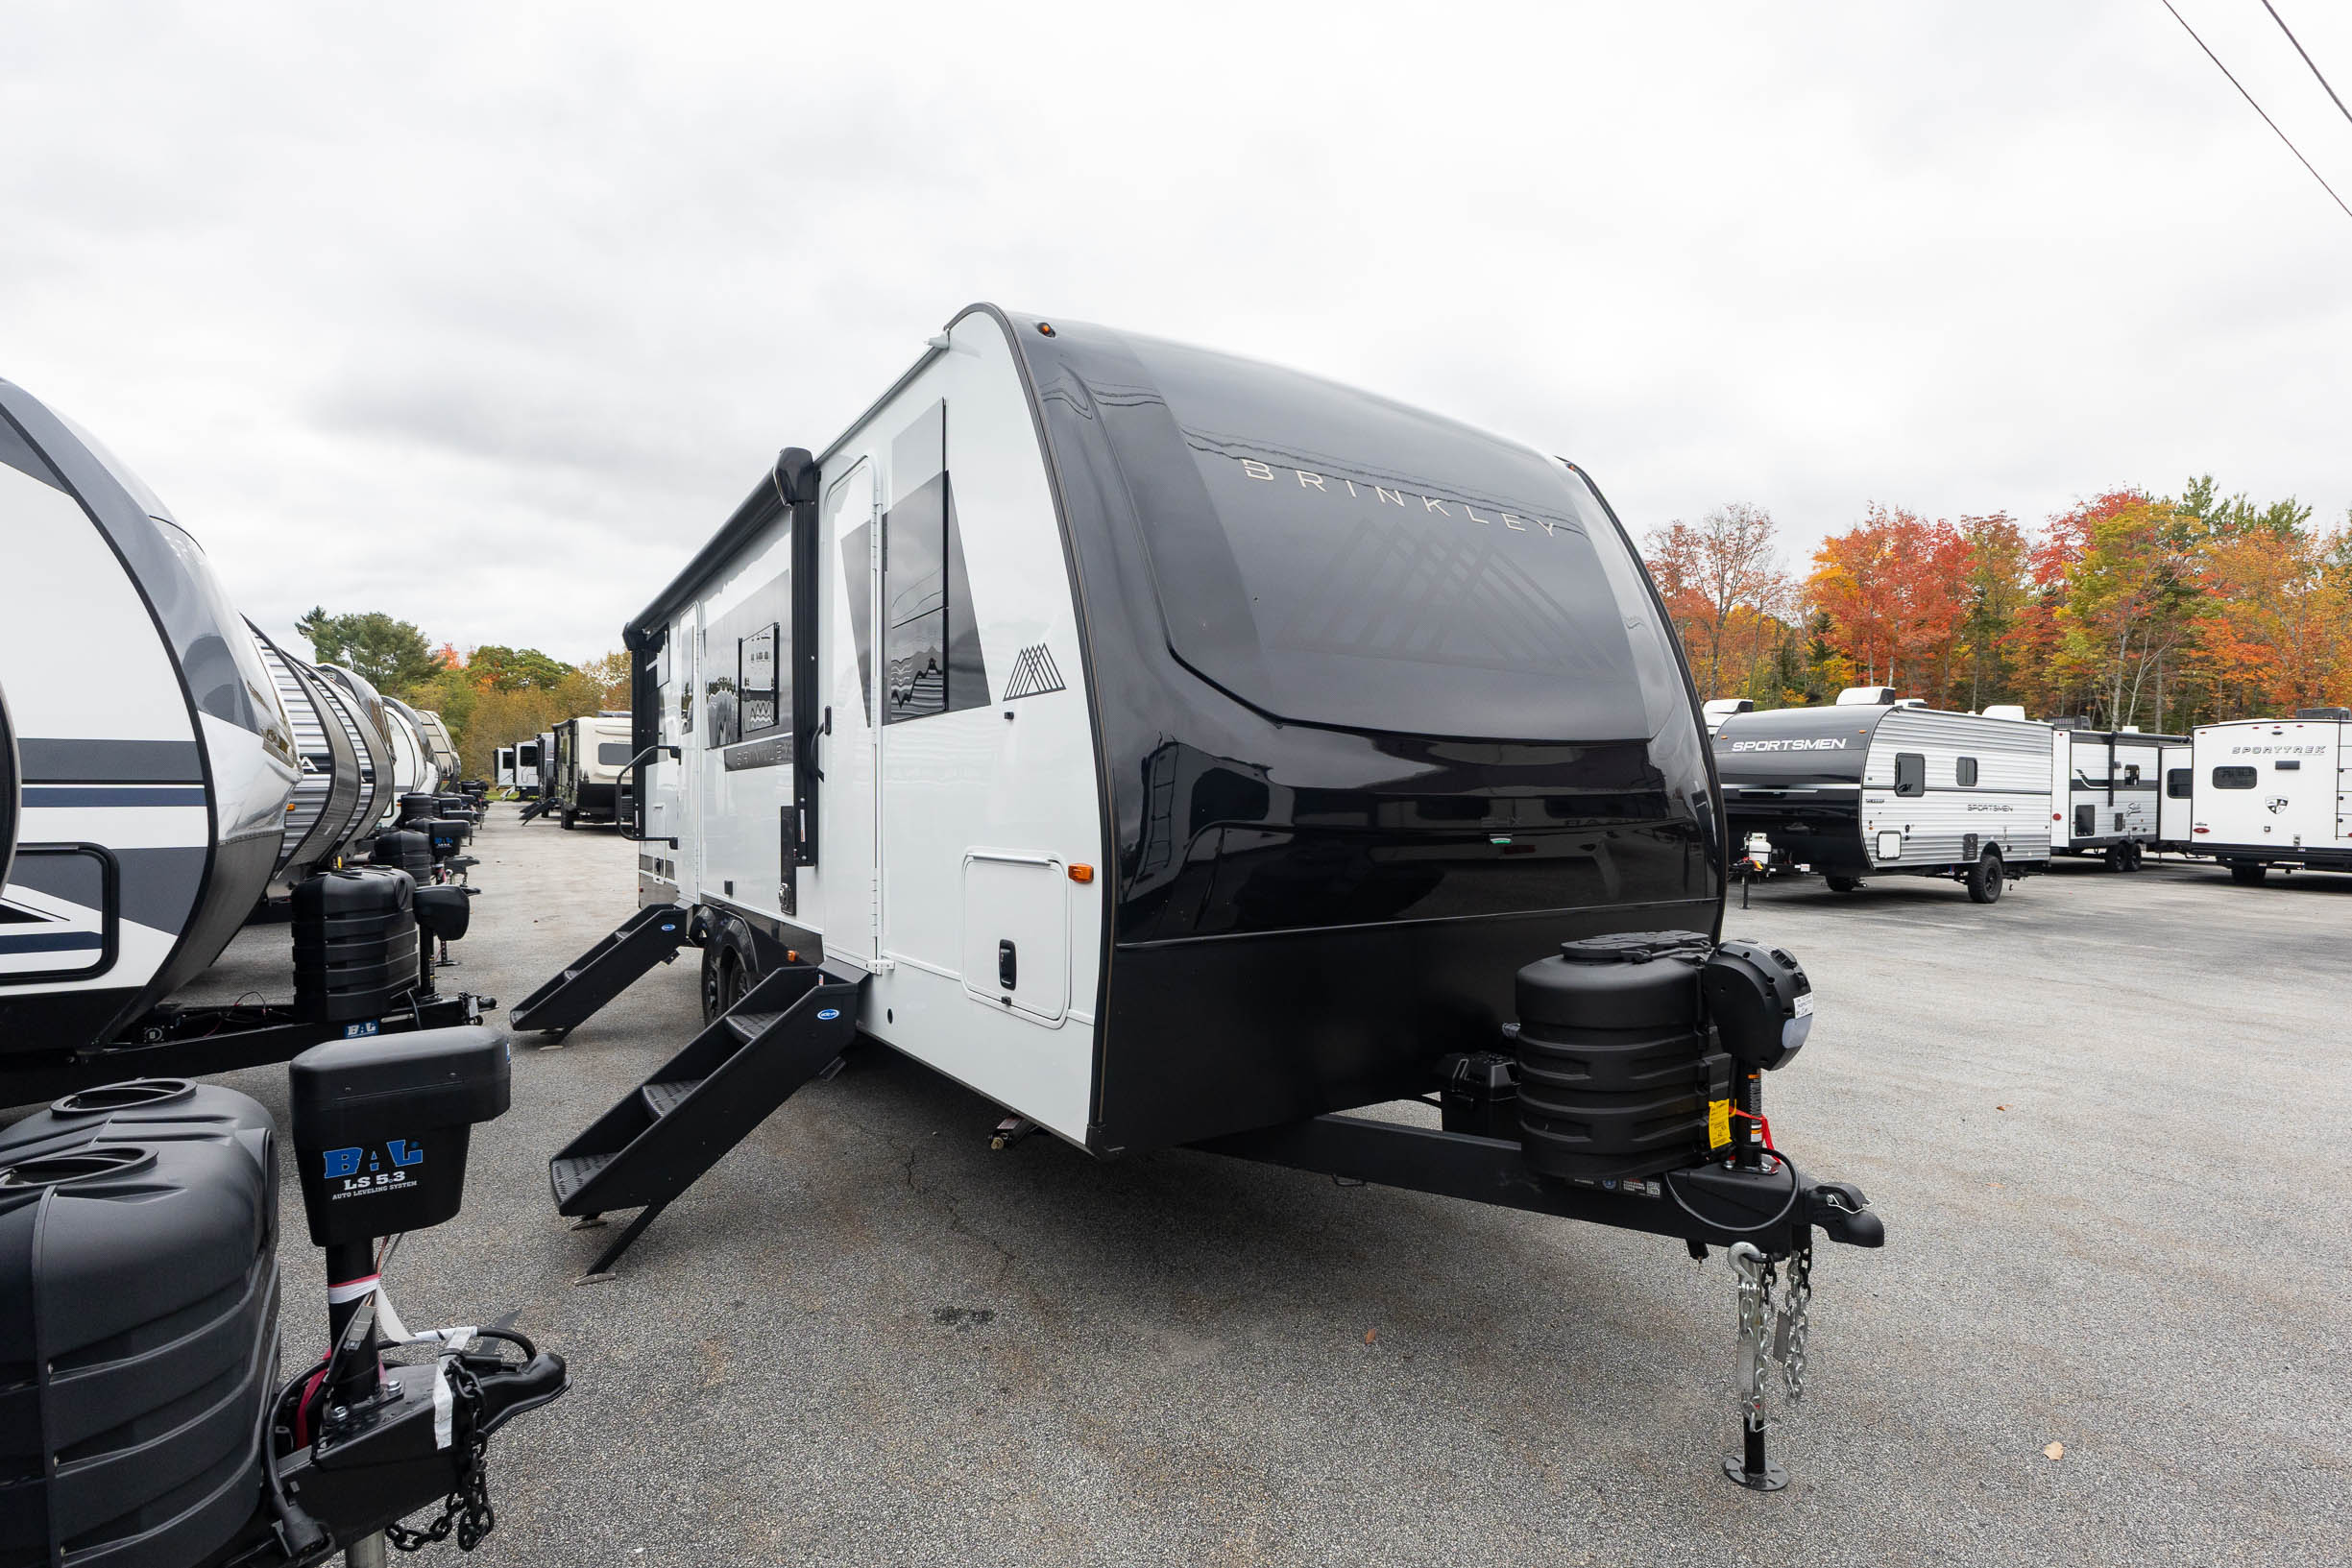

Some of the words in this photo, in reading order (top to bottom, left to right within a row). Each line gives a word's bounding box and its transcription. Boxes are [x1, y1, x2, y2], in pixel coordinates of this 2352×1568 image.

[1242, 458, 1554, 538] BRINKLEY
[1732, 738, 1847, 752] SPORTSMEN
[332, 1192, 352, 1200] AUTO
[353, 1185, 388, 1196] LEVELING
[389, 1180, 418, 1191] SYSTEM
[344, 1176, 371, 1191] LS
[376, 1170, 405, 1185] 5.3
